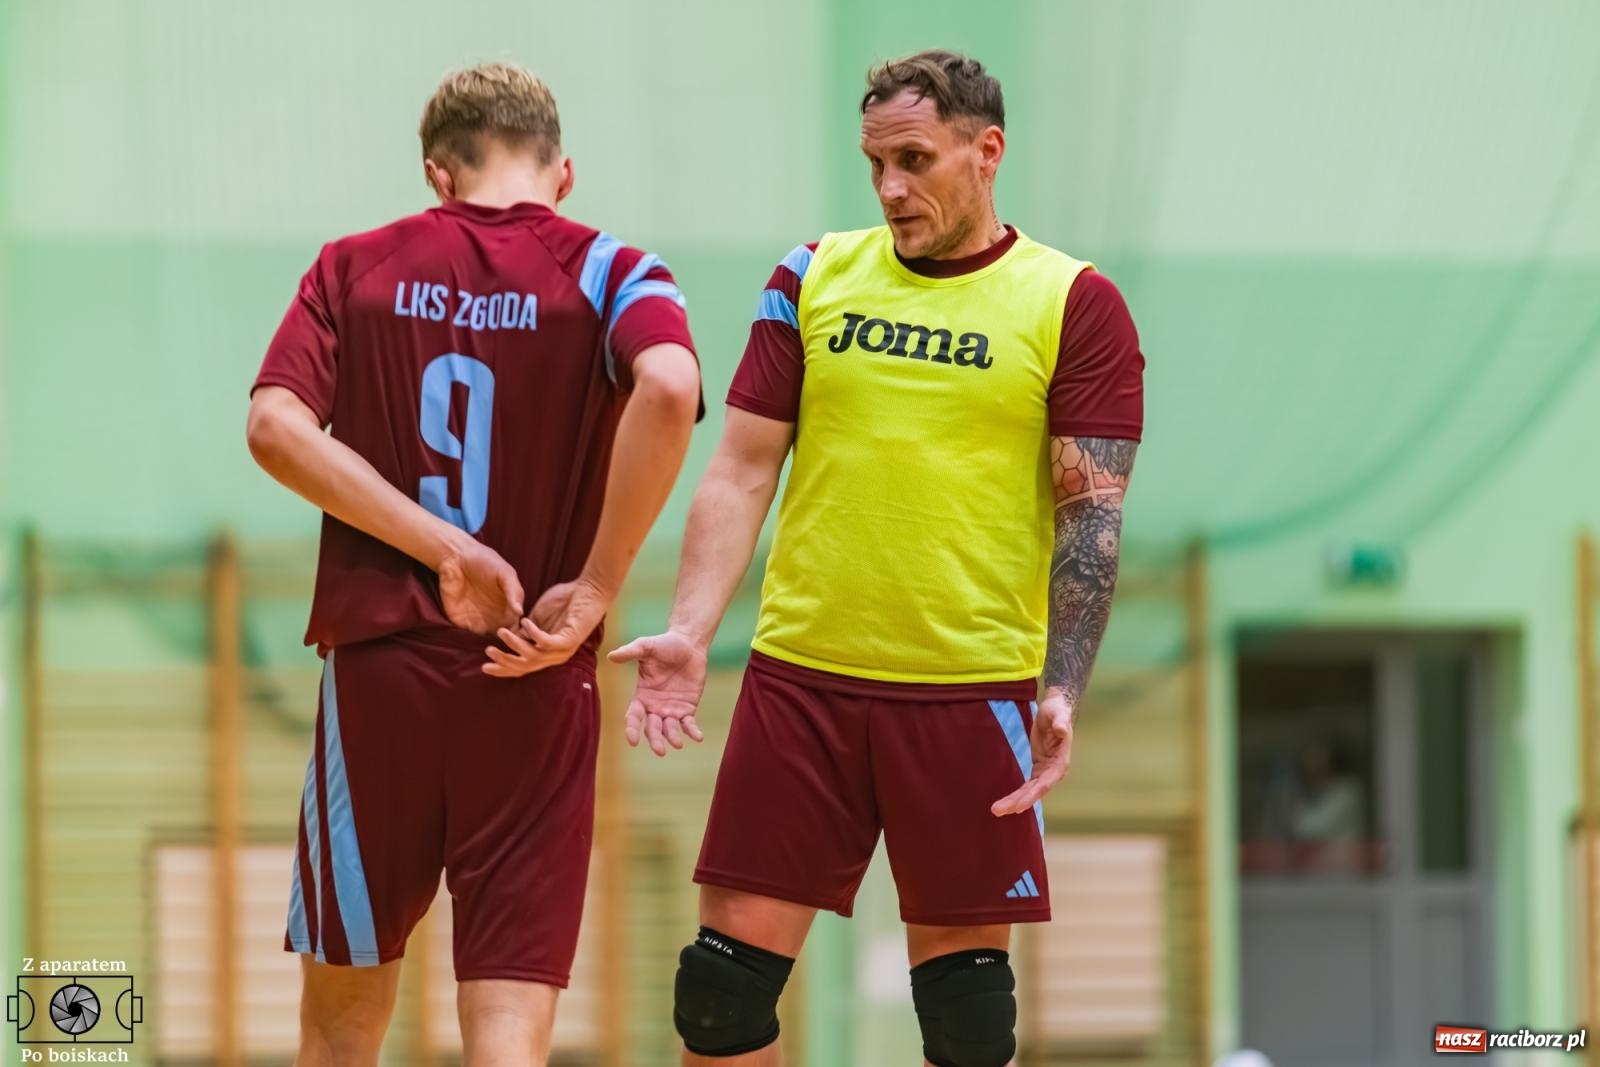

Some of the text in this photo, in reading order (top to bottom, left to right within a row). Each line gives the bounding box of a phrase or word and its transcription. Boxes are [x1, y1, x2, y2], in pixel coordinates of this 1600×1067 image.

[394, 281, 538, 331] LKS ZGODA
[828, 312, 994, 370] Joma
[419, 352, 495, 535] 9
